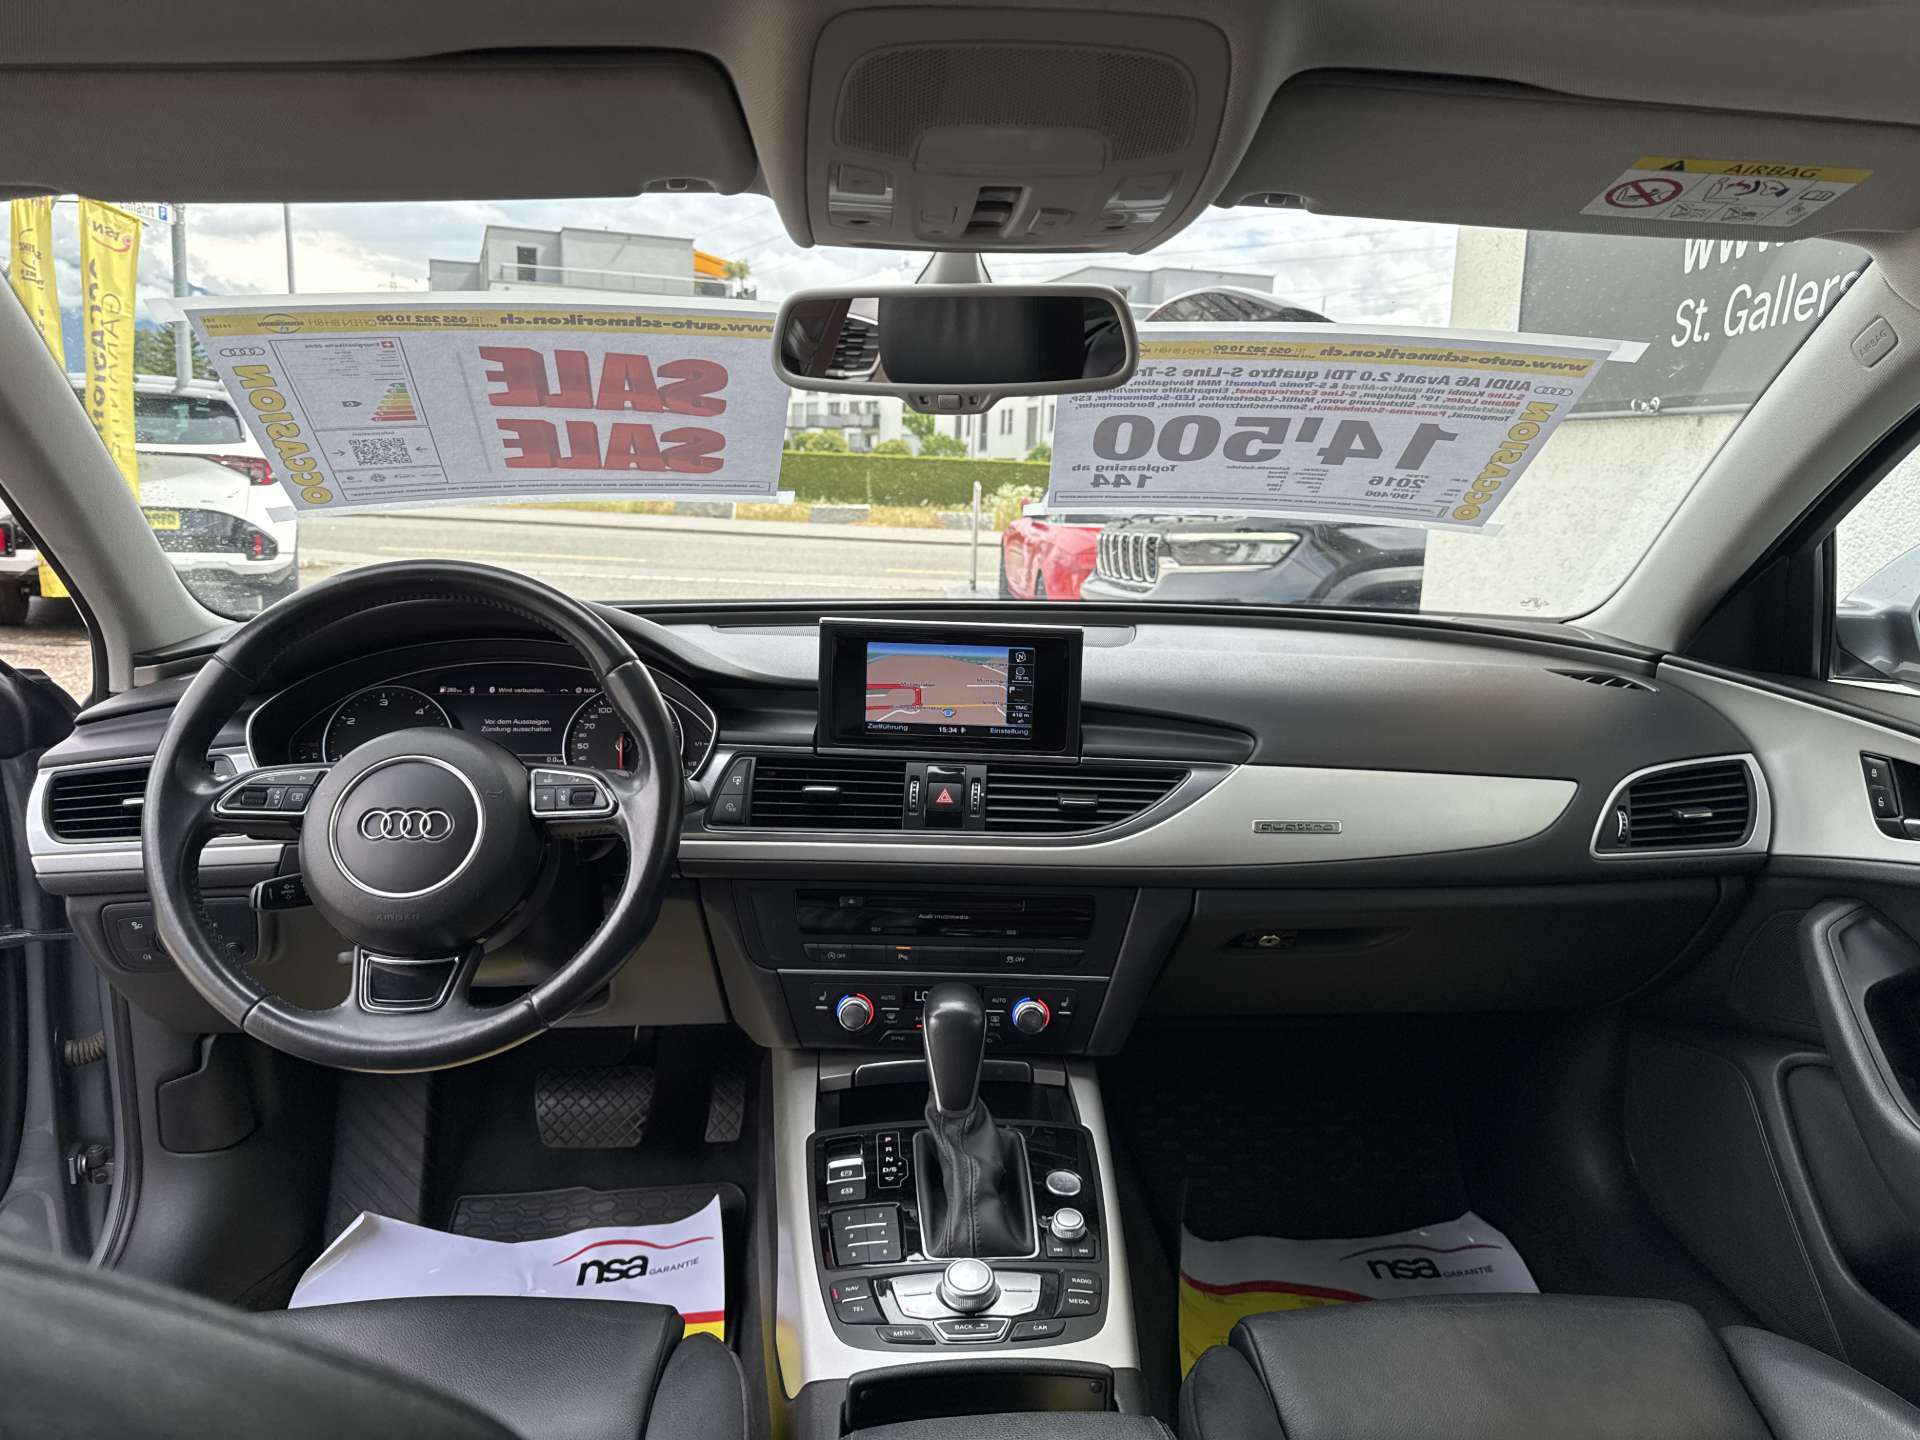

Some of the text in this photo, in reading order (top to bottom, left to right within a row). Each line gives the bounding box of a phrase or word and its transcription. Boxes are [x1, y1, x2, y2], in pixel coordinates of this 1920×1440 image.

[1725, 164, 1820, 178] AIRBAG
[1671, 298, 1711, 348] St.
[415, 707, 425, 716] 4
[346, 717, 356, 725] 2
[513, 718, 551, 727] Aussteigen
[480, 725, 512, 734] Zündung
[867, 722, 909, 732] Zielführung
[989, 726, 1029, 736] Einstellung
[576, 1255, 700, 1286] nsa GARANTIE
[1366, 1257, 1495, 1280] nsa GARANTIE
[1071, 1277, 1093, 1285] RADIO
[1068, 1297, 1091, 1305] MEDIA
[852, 1305, 865, 1313] TEL
[893, 1329, 915, 1337] MENU
